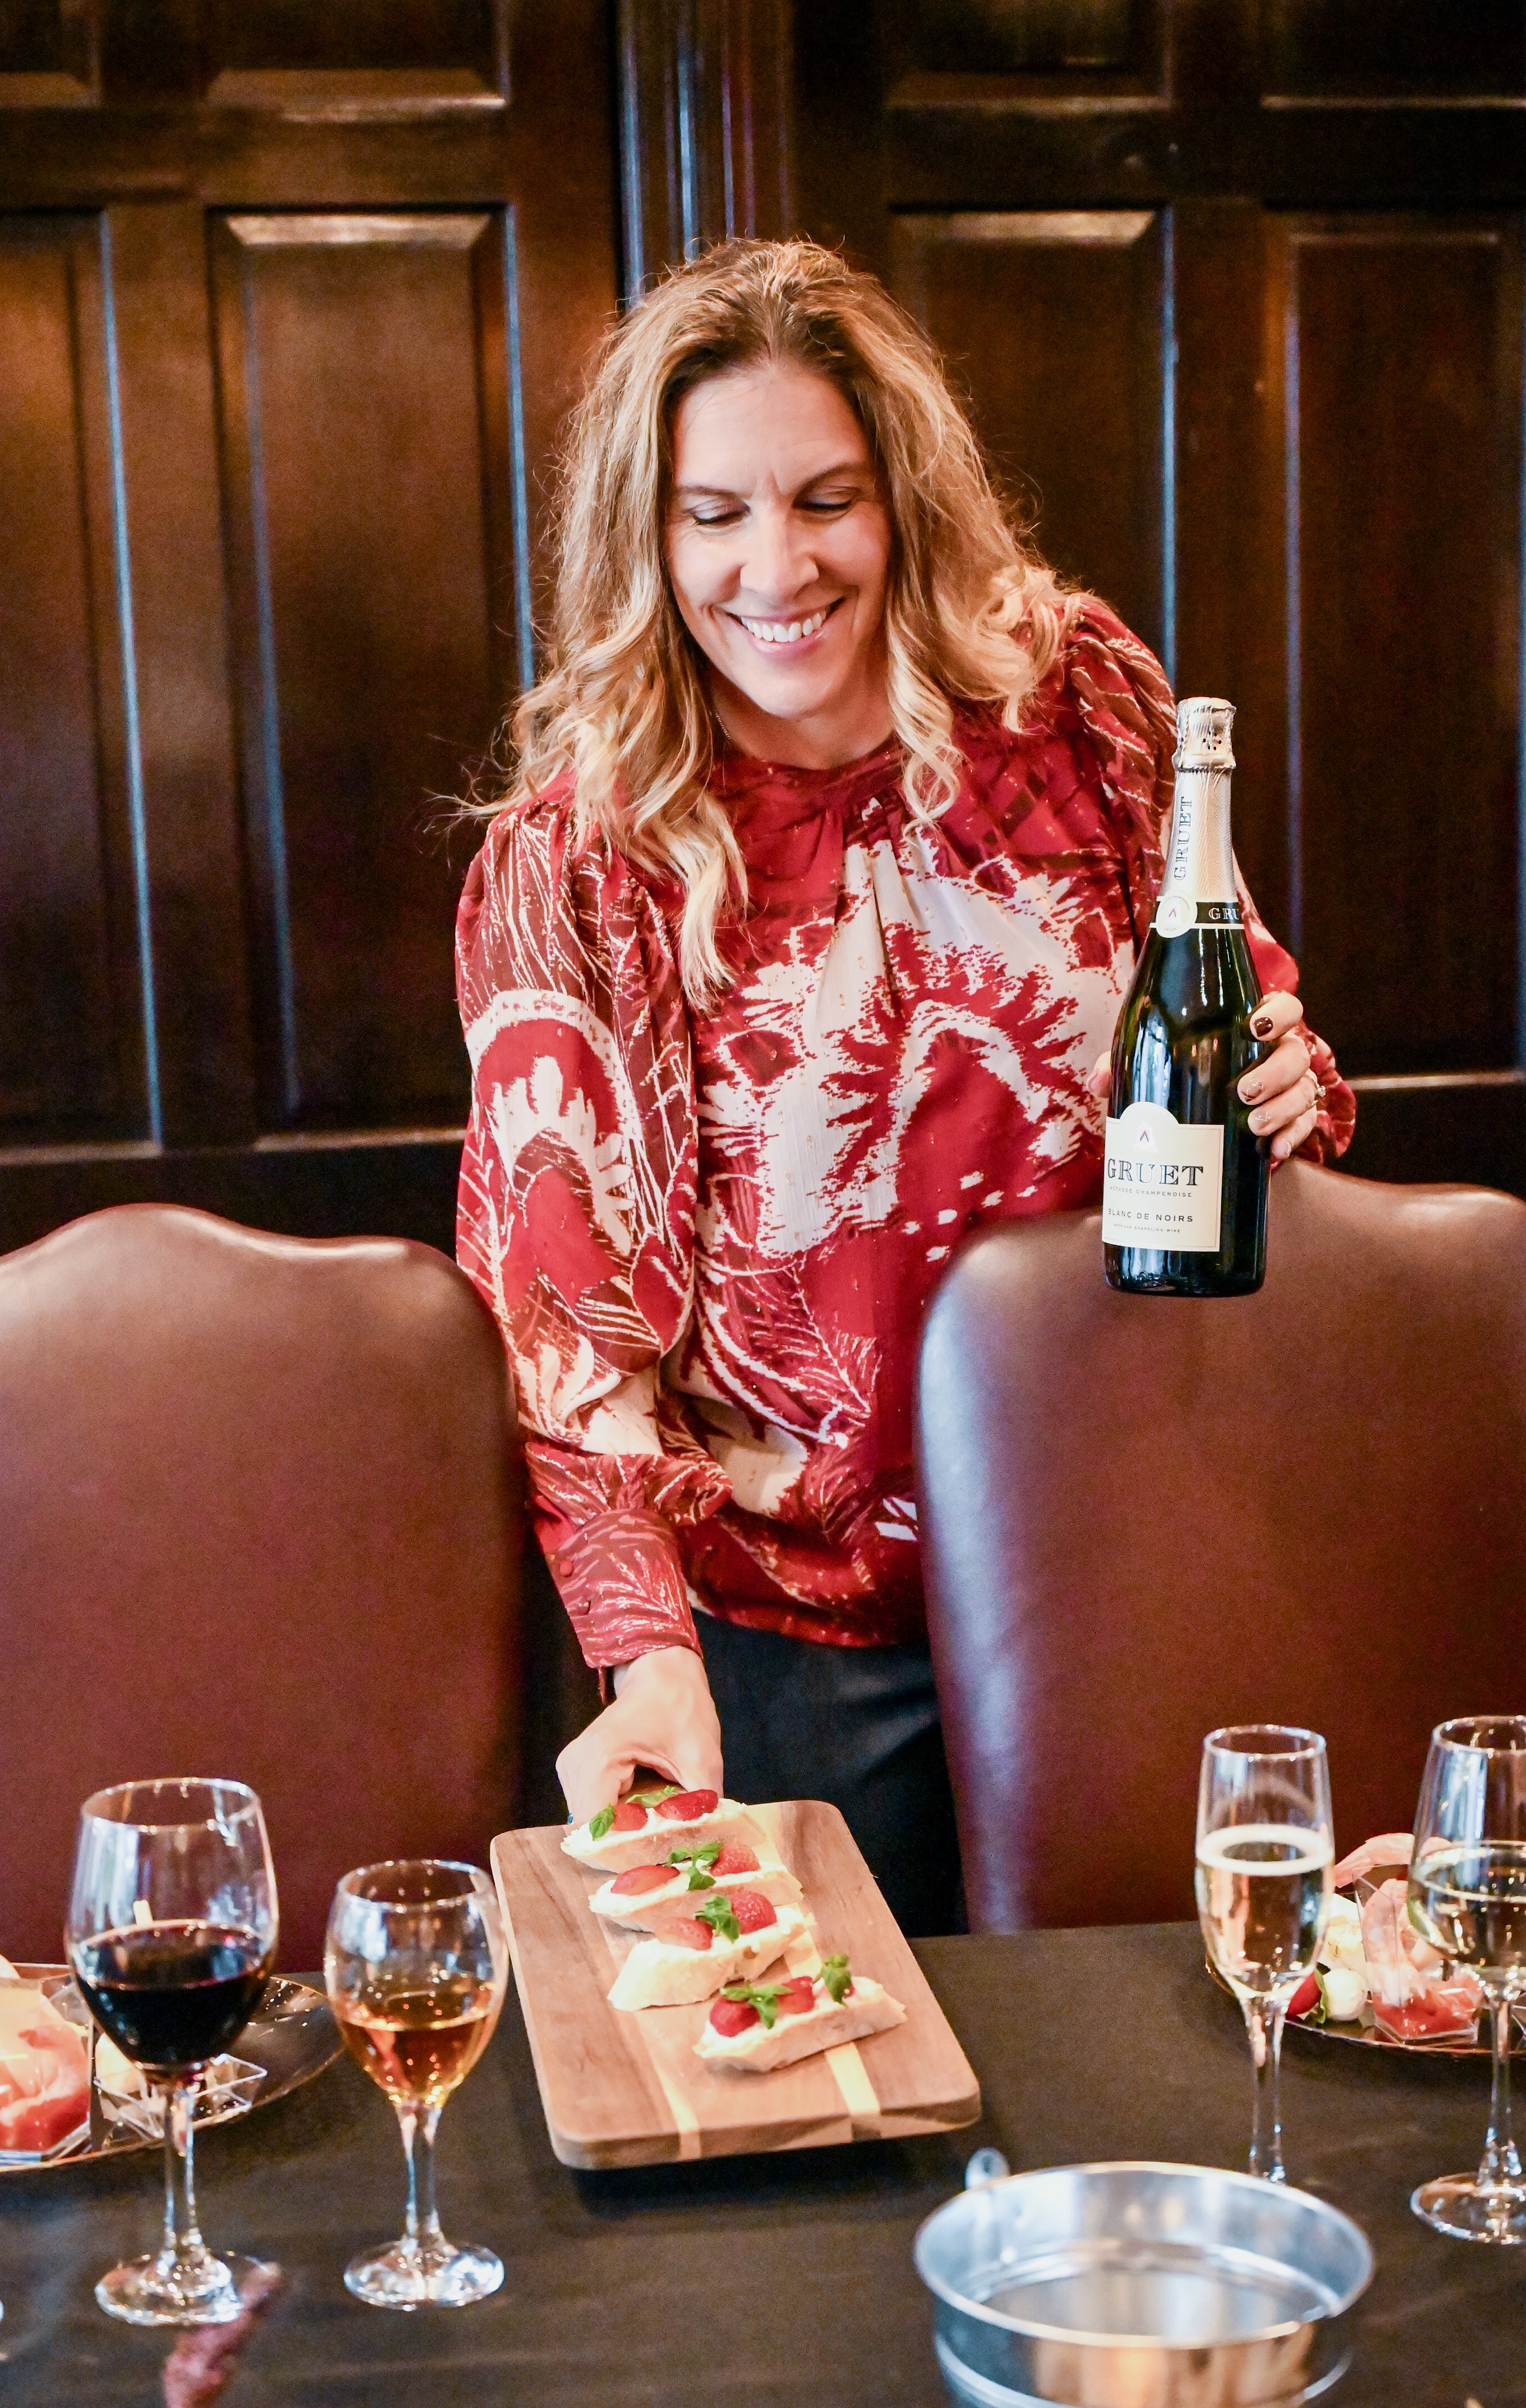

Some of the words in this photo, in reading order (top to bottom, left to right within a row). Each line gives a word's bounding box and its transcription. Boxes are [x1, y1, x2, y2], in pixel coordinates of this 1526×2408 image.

[1174, 796, 1192, 880] GRUET
[1107, 1158, 1203, 1186] GRUET
[1108, 1208, 1132, 1218] BLANC
